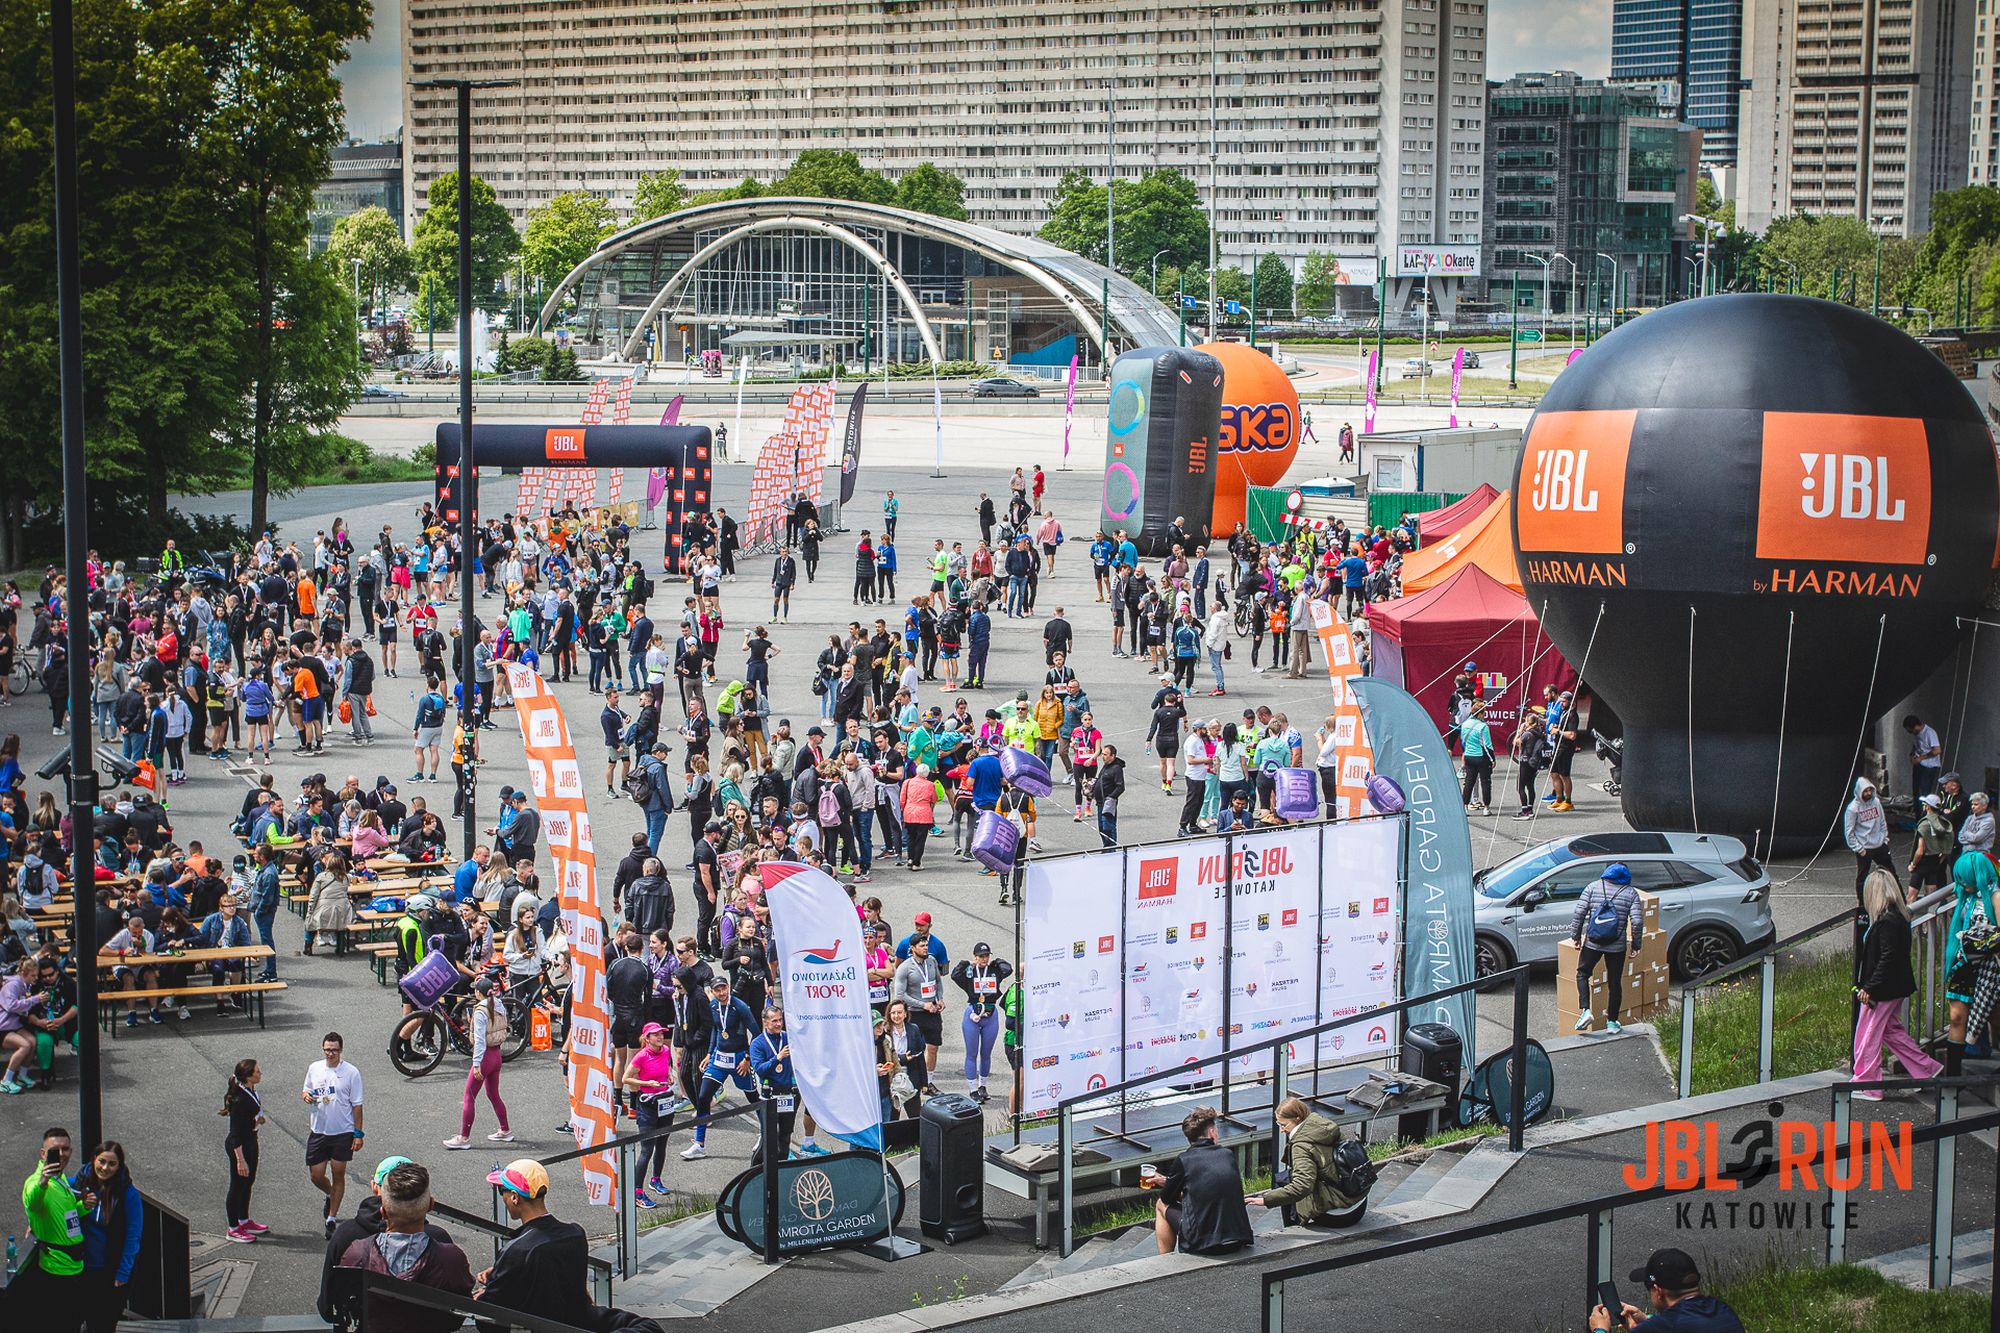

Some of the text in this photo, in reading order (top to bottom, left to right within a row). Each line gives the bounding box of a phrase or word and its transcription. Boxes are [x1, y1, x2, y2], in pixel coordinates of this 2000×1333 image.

[554, 436, 578, 451] JBL
[1188, 436, 1208, 474] JBL
[1532, 449, 1599, 512] JBL
[1800, 453, 1906, 521] JBL
[1529, 560, 1627, 587] HARMAN
[1753, 569, 1922, 598] by HARMAN
[1289, 772, 1310, 802] JBL
[414, 965, 452, 997] JBL
[826, 1213, 876, 1232] GARDEN
[787, 1237, 822, 1248] MILLENIUM
[823, 1229, 865, 1242] INWESTYCJE
